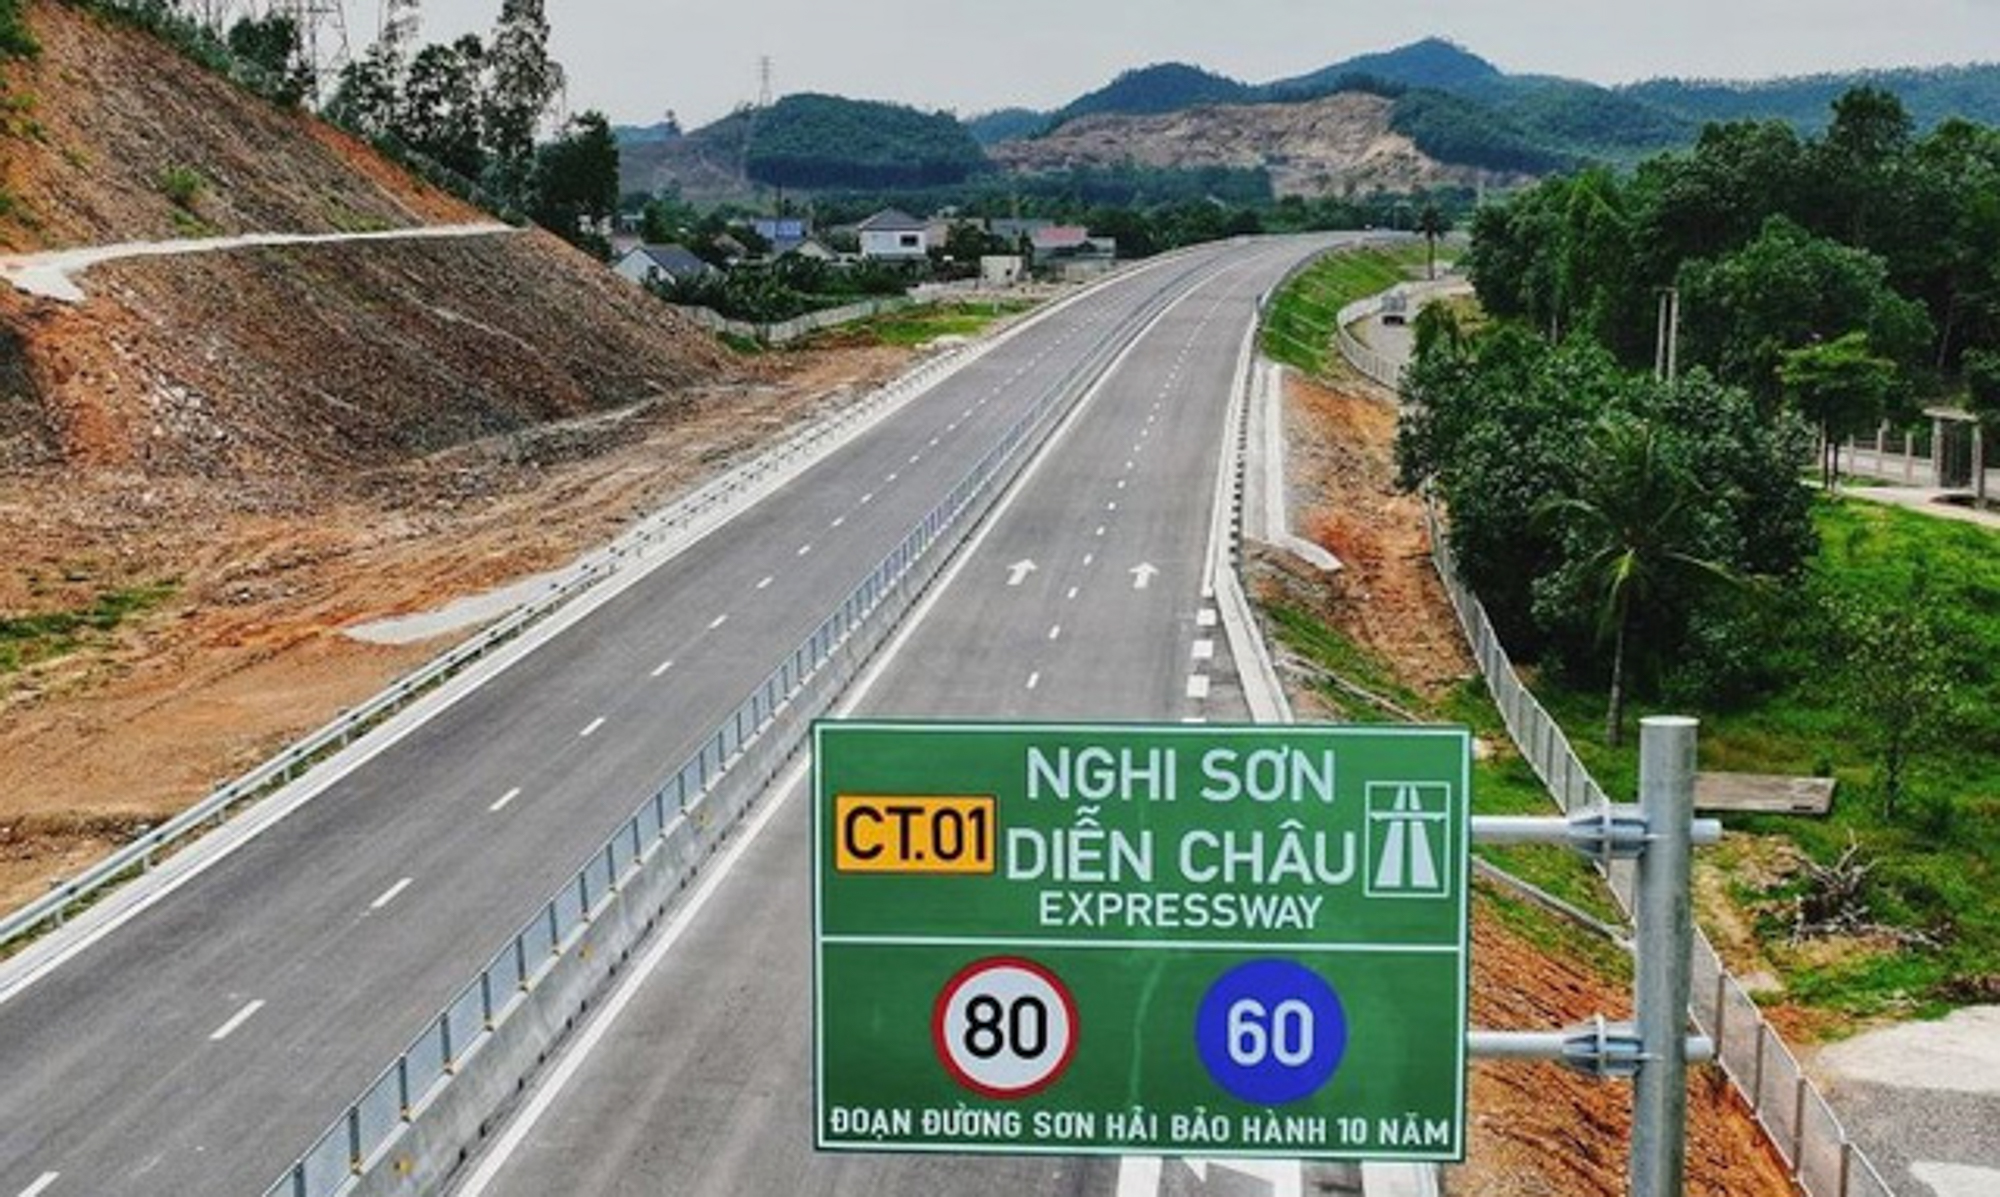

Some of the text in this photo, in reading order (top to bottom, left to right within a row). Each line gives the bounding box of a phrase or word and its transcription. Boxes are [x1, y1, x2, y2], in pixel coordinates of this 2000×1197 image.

[1027, 745, 1334, 802] NGHI SƠN
[844, 806, 986, 860] CT.01
[1007, 806, 1355, 884] DIỄN CHÂU
[1040, 893, 1323, 929] EXPRESSWAY
[964, 995, 1048, 1059] 80
[1227, 999, 1314, 1066] 60
[830, 1102, 1449, 1146] ĐOẠN ĐƯỜNG SƠN HẢI BẢO HÀNH 10 NĂM
